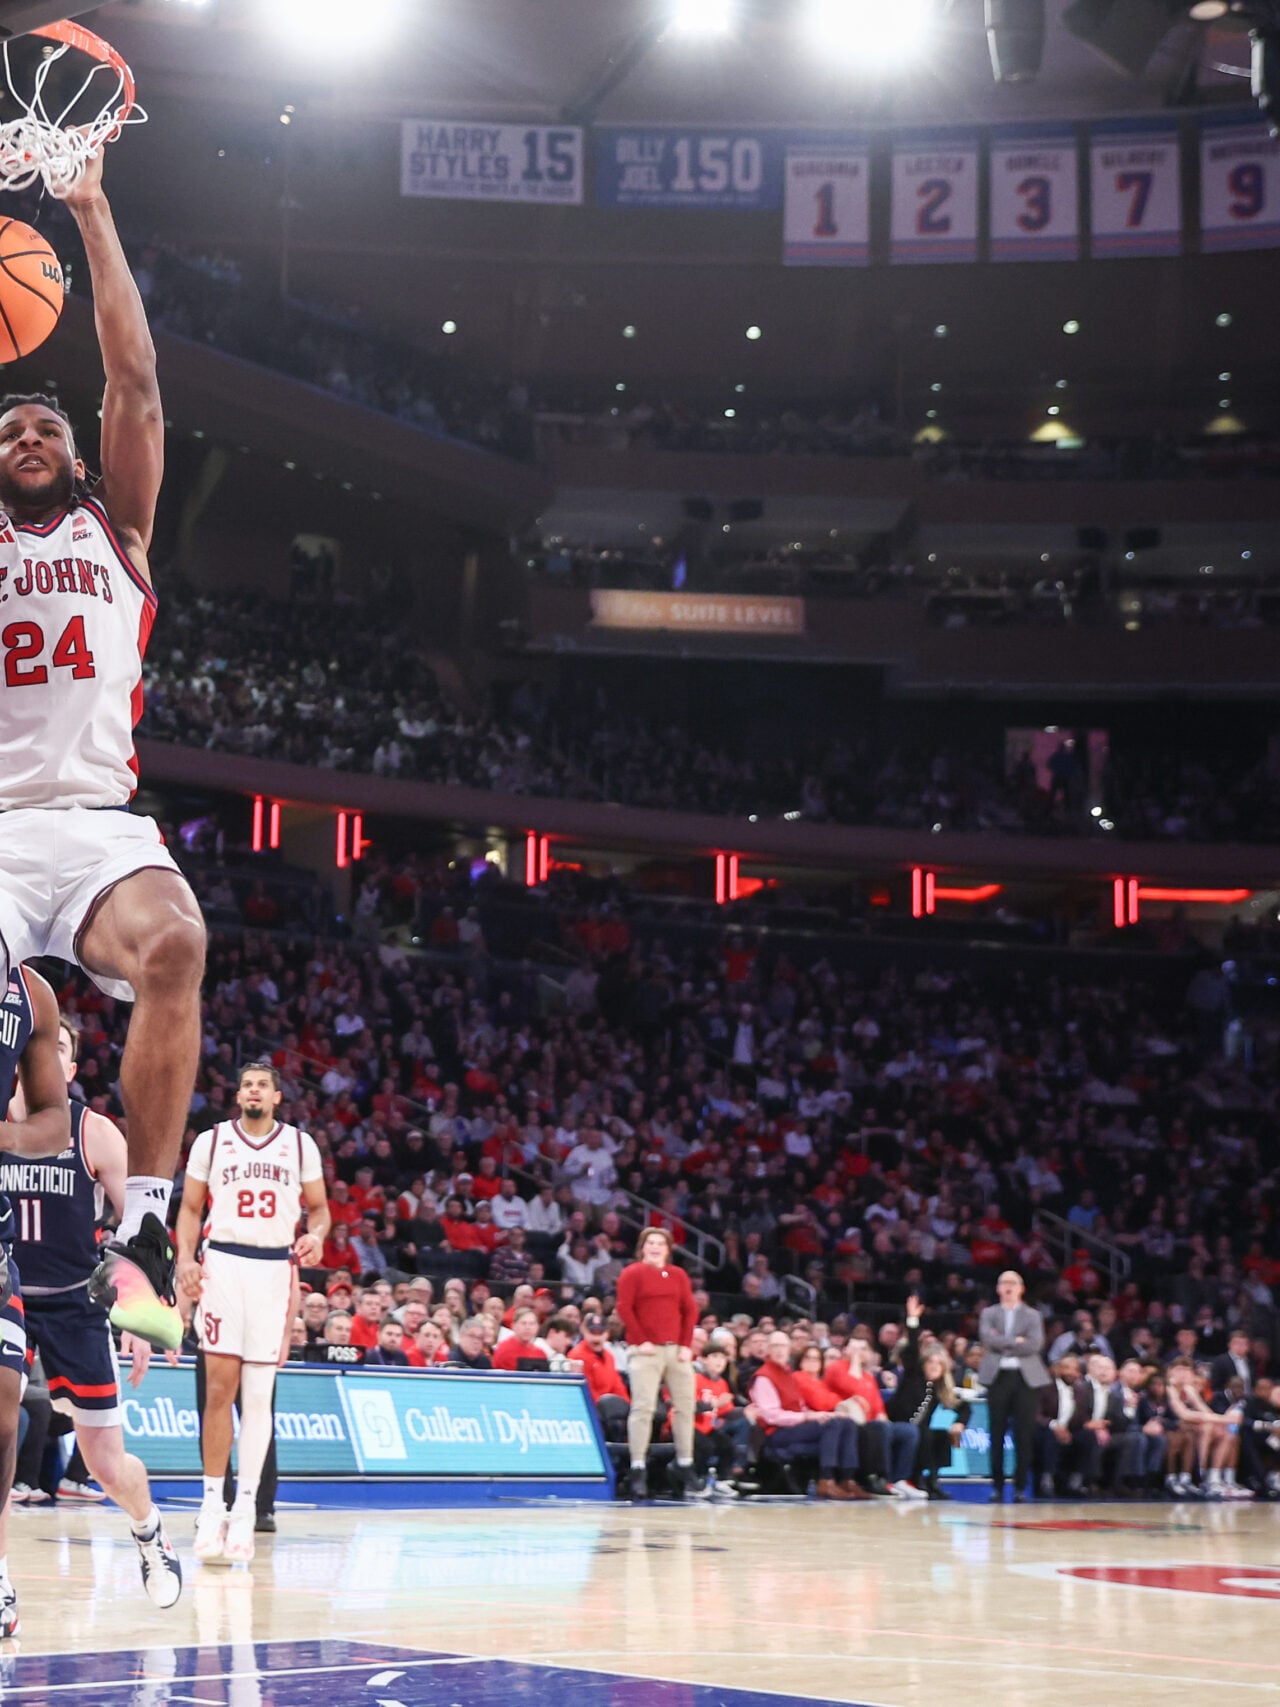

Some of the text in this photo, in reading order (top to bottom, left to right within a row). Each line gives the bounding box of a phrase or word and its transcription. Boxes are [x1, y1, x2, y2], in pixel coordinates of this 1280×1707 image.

[417, 126, 501, 150] HARRY
[522, 130, 576, 181] 15
[410, 152, 509, 179] STYLES
[671, 138, 762, 191] 150
[813, 182, 838, 237] 1
[916, 178, 952, 235] 2
[1015, 176, 1052, 233] 3
[1115, 171, 1153, 227] 7
[1226, 163, 1265, 220] 9
[14, 558, 114, 605] JOHN'S
[671, 602, 727, 623] SUITE
[734, 605, 794, 625] LEVEL
[2, 615, 96, 688] 24
[222, 1161, 290, 1187] ST. JOHN'S
[18, 1198, 42, 1242] 11
[237, 1189, 277, 1218] 23
[327, 1345, 358, 1363] POSS
[405, 1406, 593, 1453] Cullen Dykman
